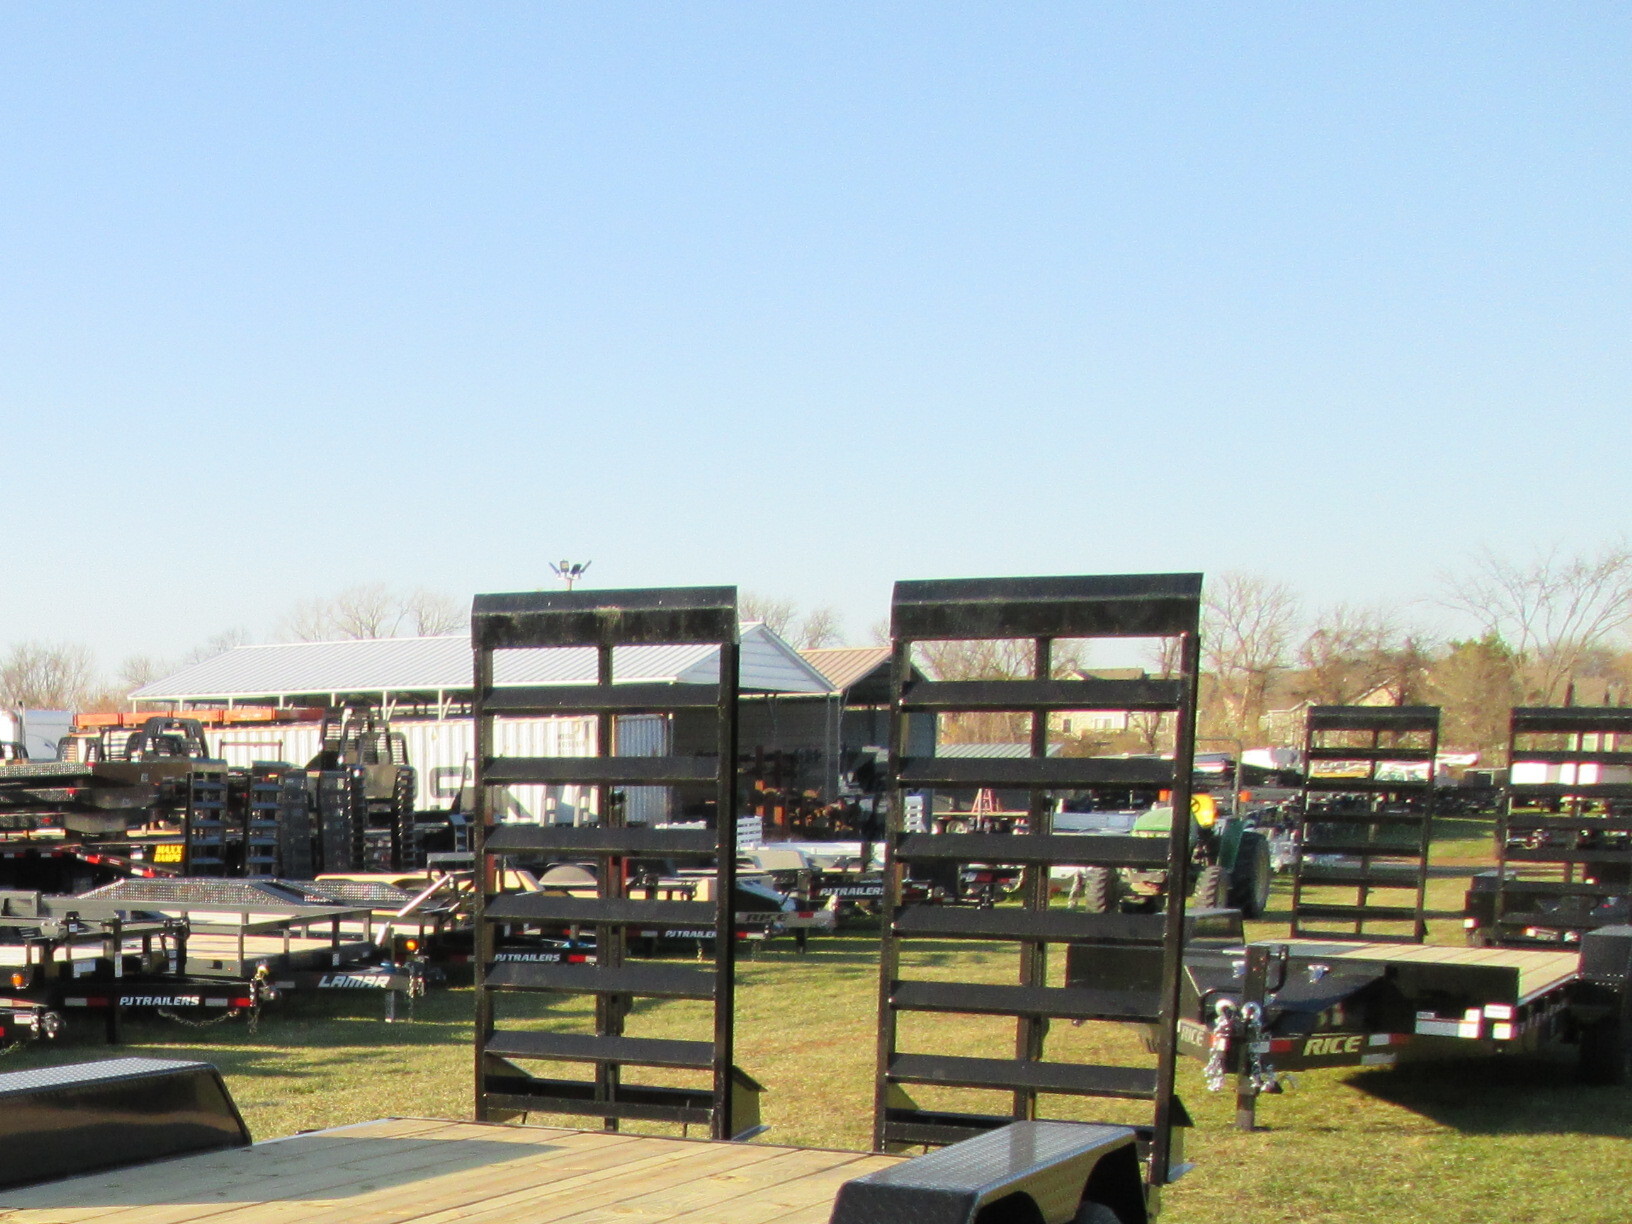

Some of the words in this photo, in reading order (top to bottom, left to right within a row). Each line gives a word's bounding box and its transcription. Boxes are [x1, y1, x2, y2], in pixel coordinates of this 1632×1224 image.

[508, 954, 561, 962] TRAILERS
[318, 975, 391, 989] LAMAR
[135, 995, 200, 1006] TRAILERS
[1180, 1022, 1204, 1048] RICE
[1303, 1034, 1363, 1057] RICE
